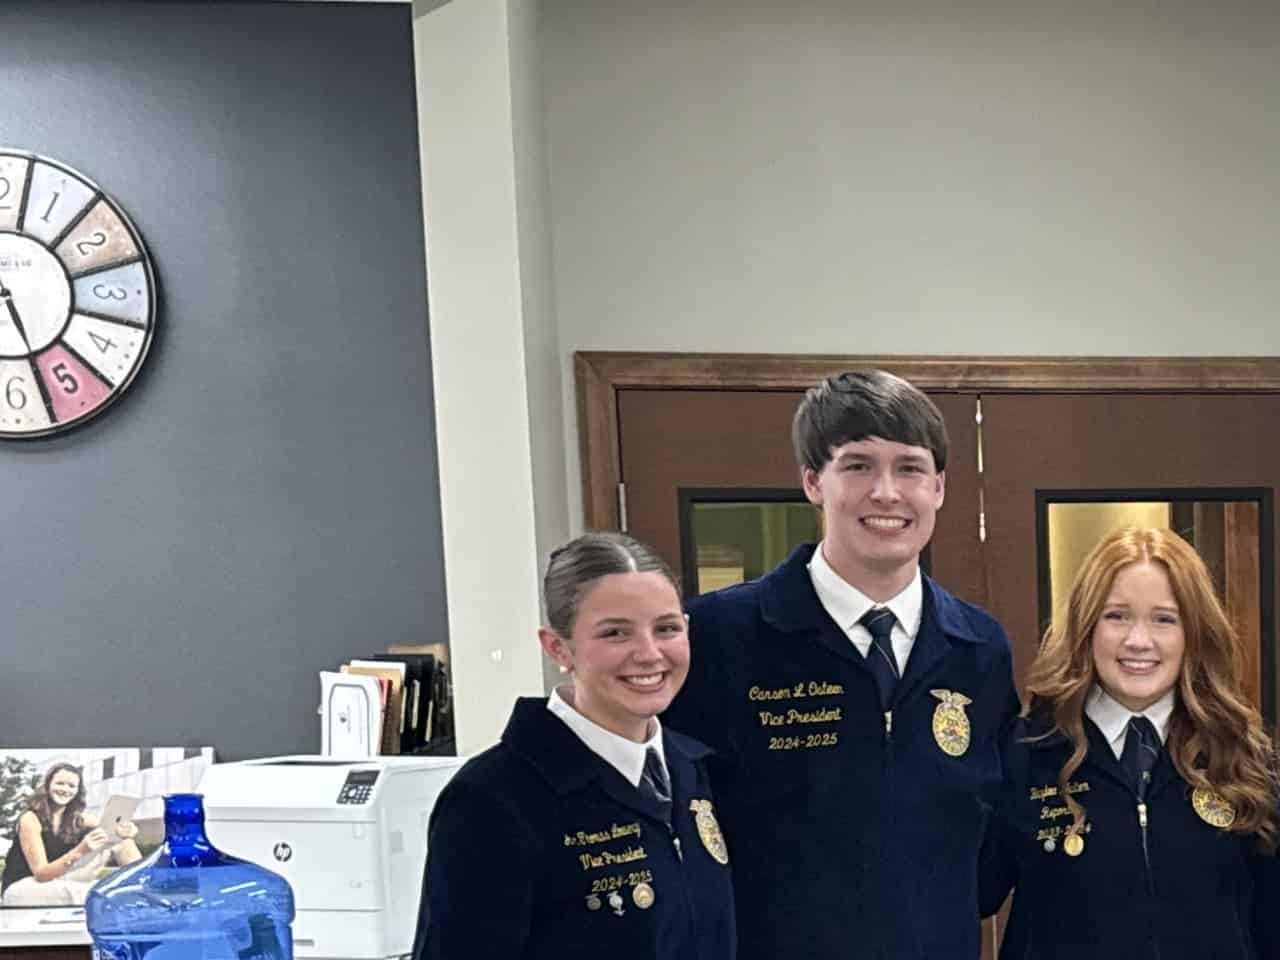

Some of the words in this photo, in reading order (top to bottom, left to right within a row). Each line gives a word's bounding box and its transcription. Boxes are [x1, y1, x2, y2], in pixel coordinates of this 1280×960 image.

[40, 191, 60, 223] 1
[76, 231, 107, 257] 2
[92, 283, 128, 301] 3
[87, 330, 118, 355] 4
[52, 362, 79, 395] 5
[5, 376, 28, 410] 6
[759, 710, 784, 726] Vice
[786, 706, 842, 725] President
[768, 732, 838, 750] 2024-2025
[579, 853, 604, 870] Vice
[601, 846, 648, 865] President
